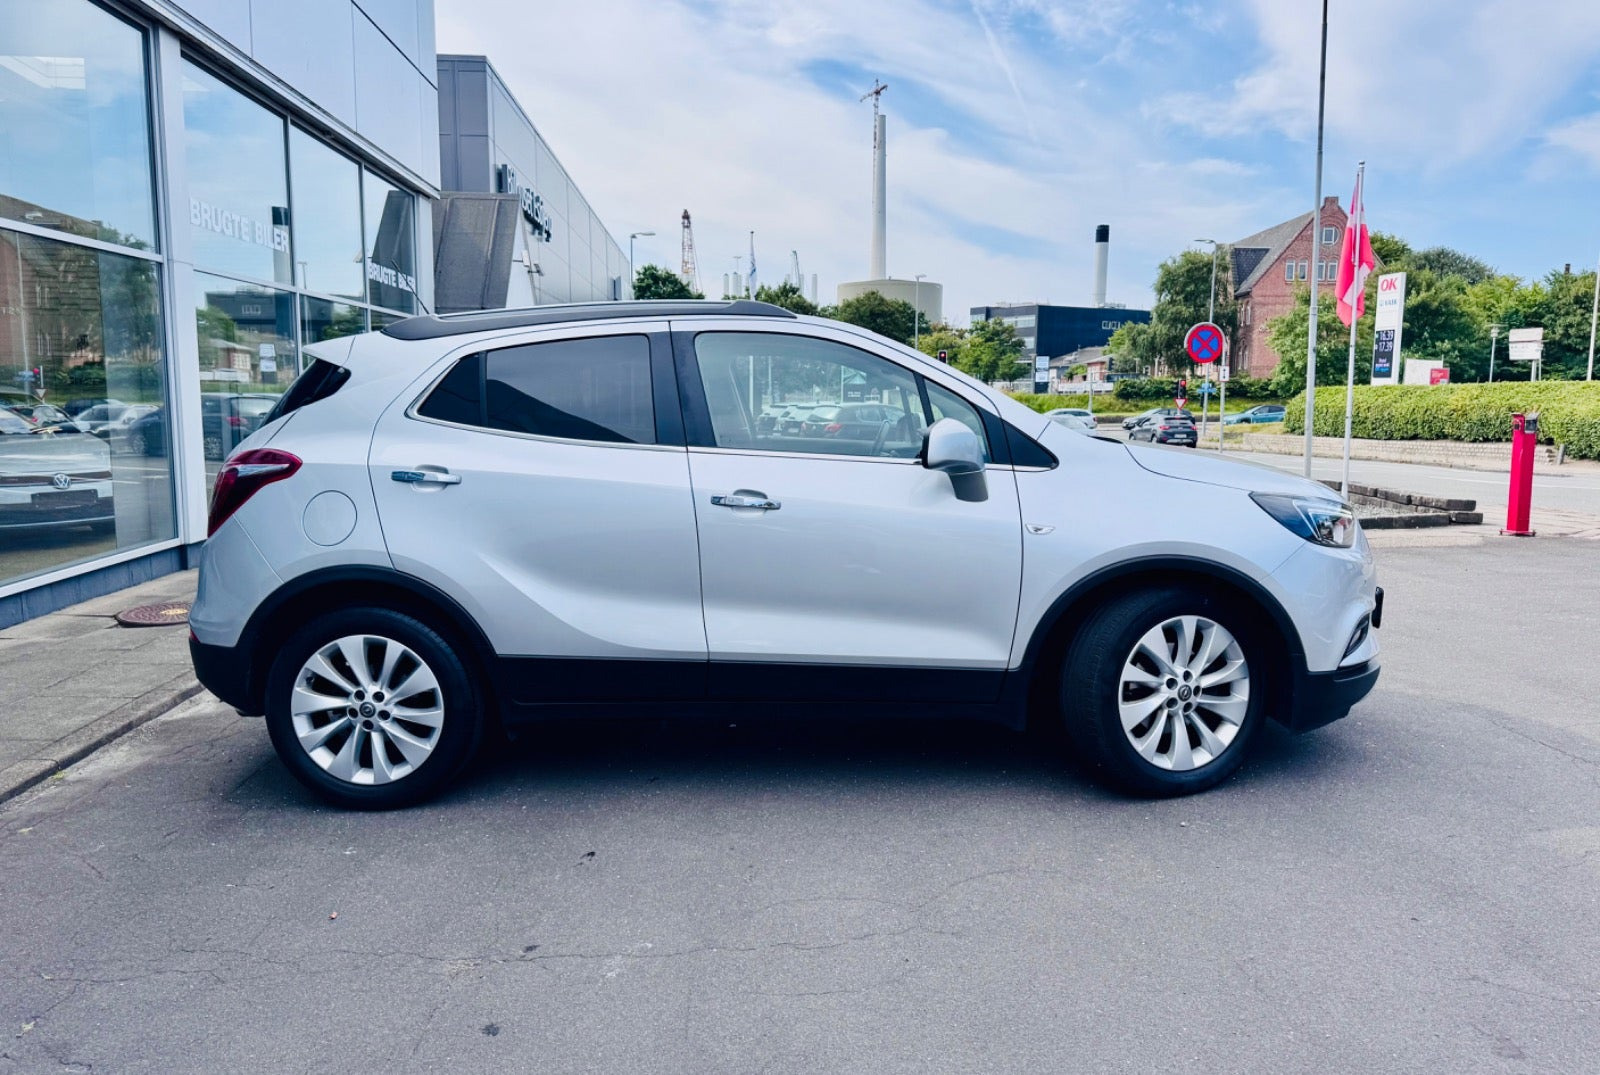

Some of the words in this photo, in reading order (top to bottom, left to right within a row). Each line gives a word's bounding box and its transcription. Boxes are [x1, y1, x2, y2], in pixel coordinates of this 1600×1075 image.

[190, 199, 250, 242] BRUGTE
[254, 221, 289, 254] BILER
[1381, 278, 1397, 291] OK
